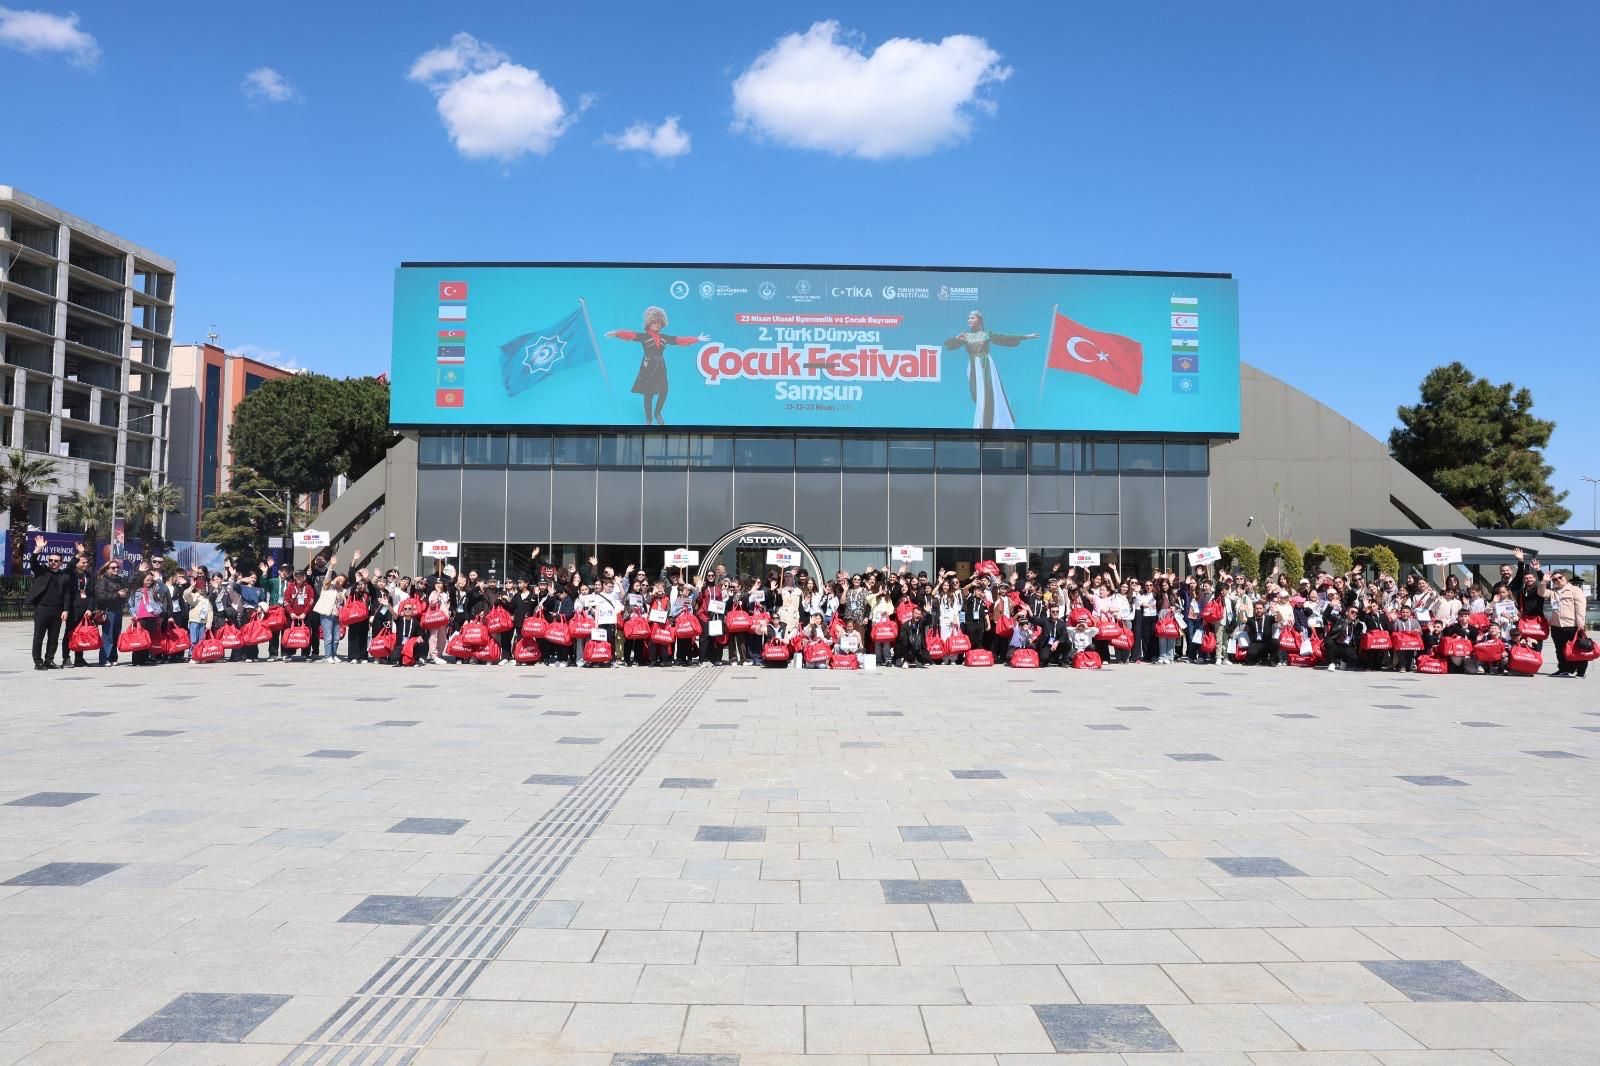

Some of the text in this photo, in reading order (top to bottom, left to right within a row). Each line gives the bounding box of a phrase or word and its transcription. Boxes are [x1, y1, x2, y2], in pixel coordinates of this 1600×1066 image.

[846, 285, 872, 298] TİKA
[751, 315, 771, 323] Nisan
[772, 315, 795, 323] Ulusal
[795, 316, 833, 324] Egemenlik
[844, 316, 867, 325] Çocuk
[867, 317, 898, 325] Bayramı
[758, 327, 880, 343] 2. Türk Dünyası
[700, 346, 938, 381] Çocuk Festivali
[774, 381, 863, 402] Samsun
[739, 536, 788, 544] ASTORYA
